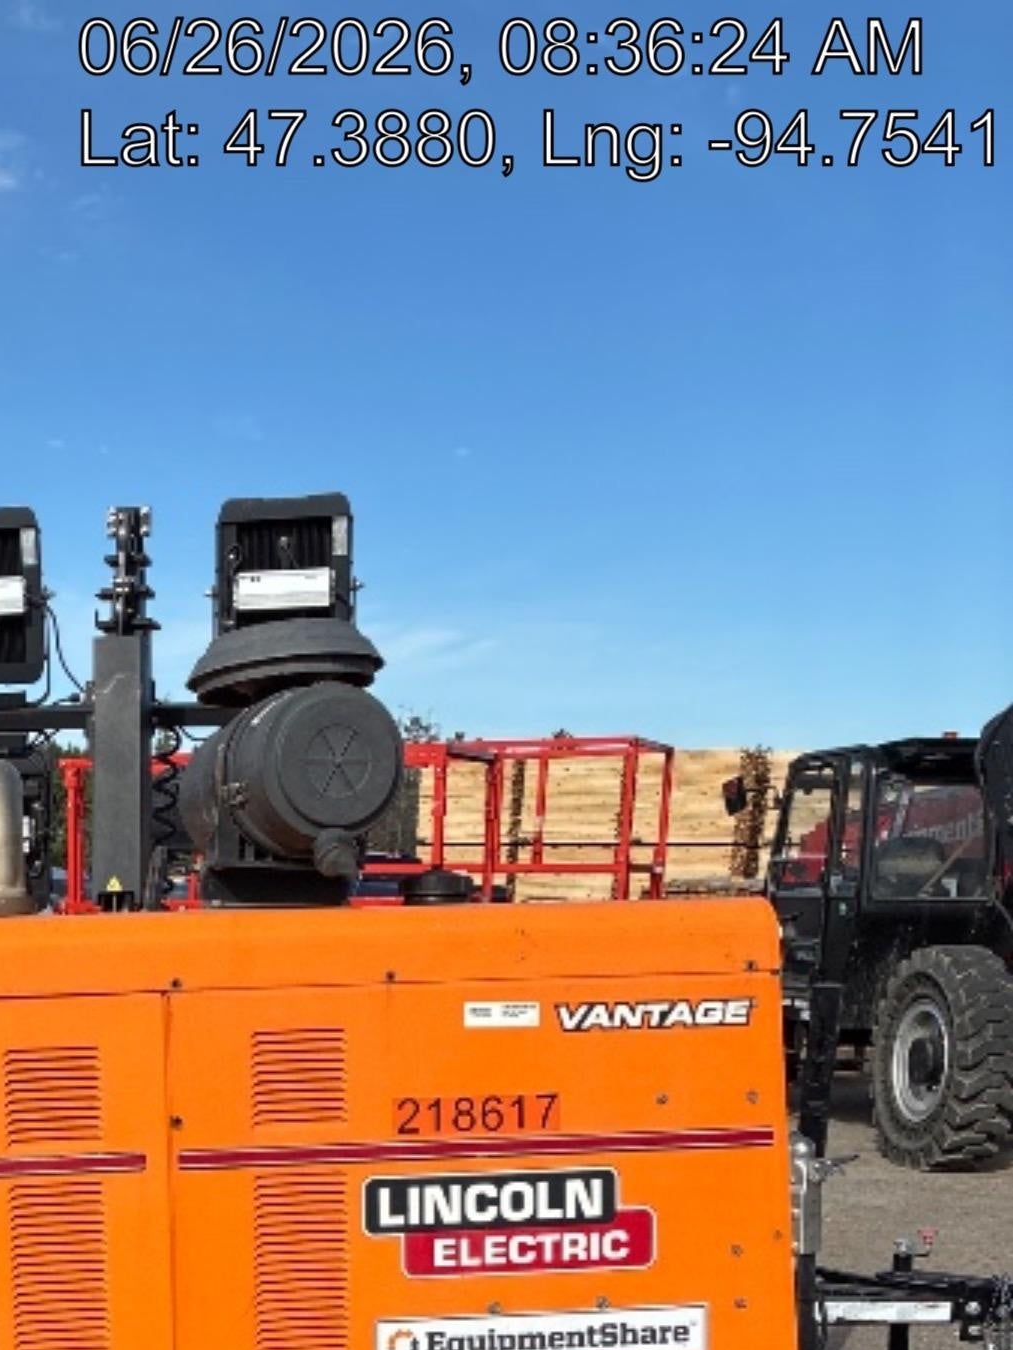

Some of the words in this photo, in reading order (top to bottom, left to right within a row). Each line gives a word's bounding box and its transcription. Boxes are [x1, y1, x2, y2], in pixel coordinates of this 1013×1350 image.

[557, 998, 753, 1031] VANTAGE
[397, 1093, 559, 1134] 218617
[378, 1178, 604, 1227] LINCOLN
[432, 1230, 630, 1267] ELECTRIC
